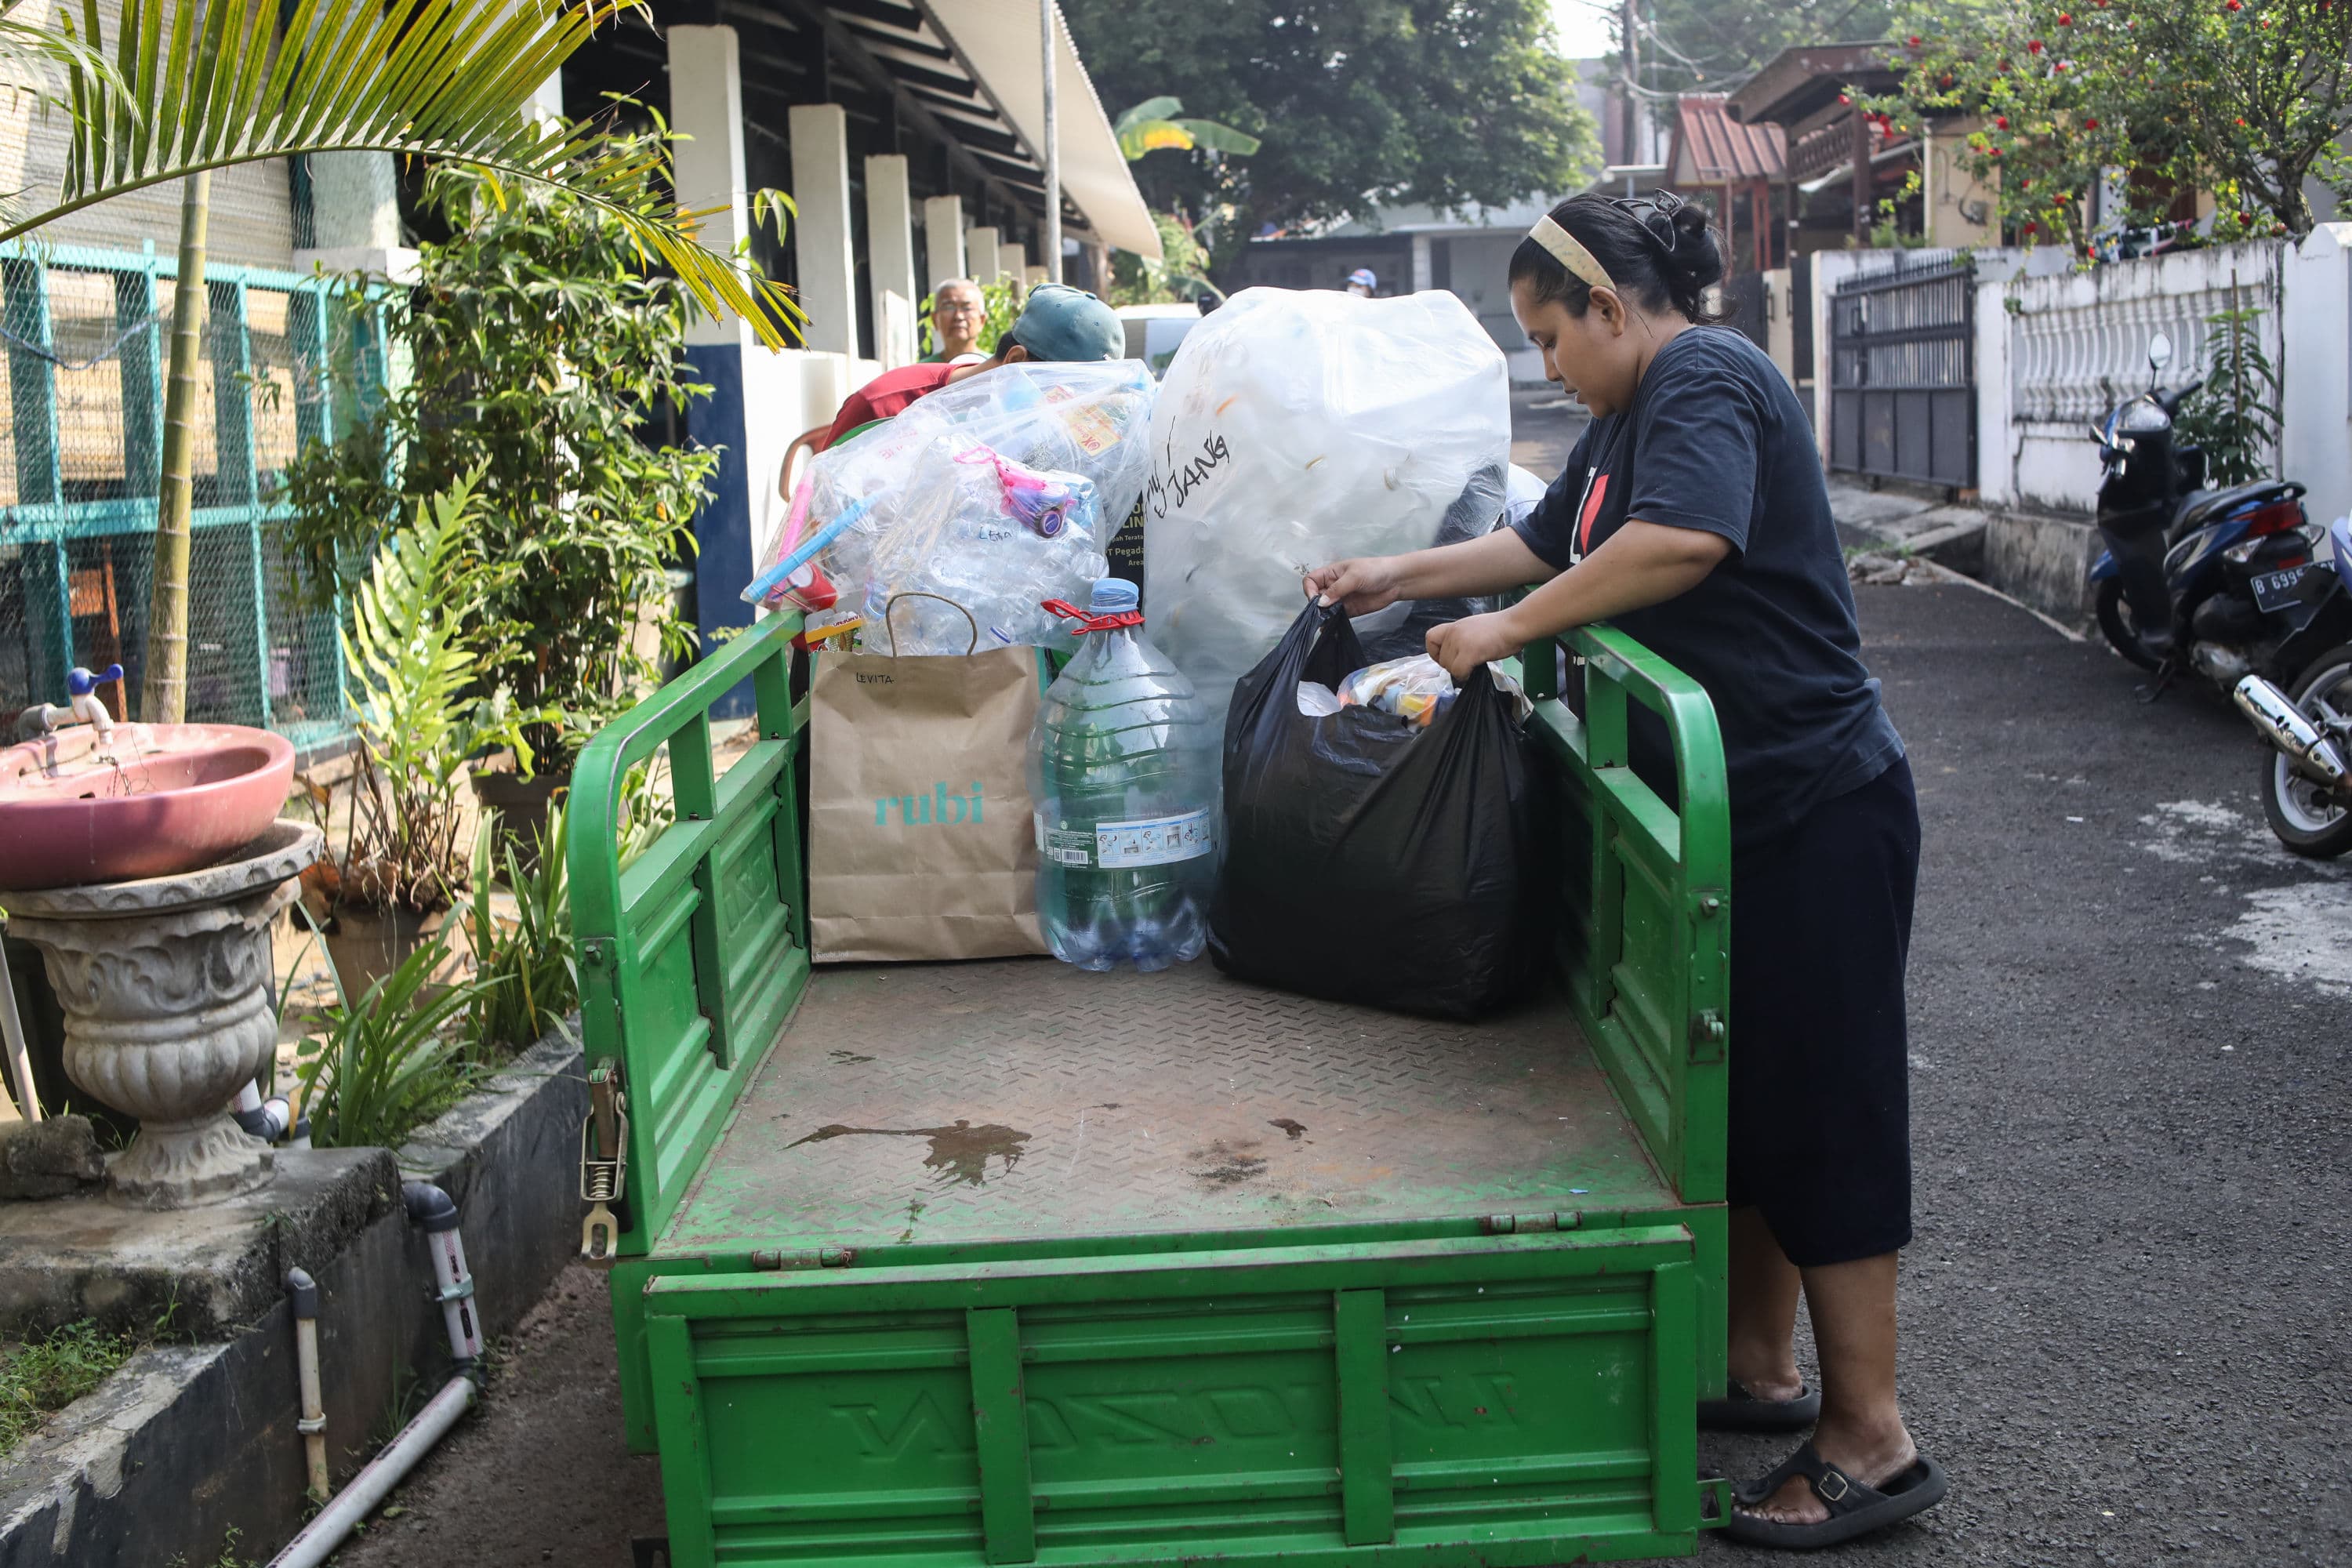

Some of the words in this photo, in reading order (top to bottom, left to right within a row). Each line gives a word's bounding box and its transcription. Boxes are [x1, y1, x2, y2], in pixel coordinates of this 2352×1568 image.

[2255, 579, 2265, 595] B
[856, 672, 895, 684] LEVITA
[873, 781, 984, 826] rubi
